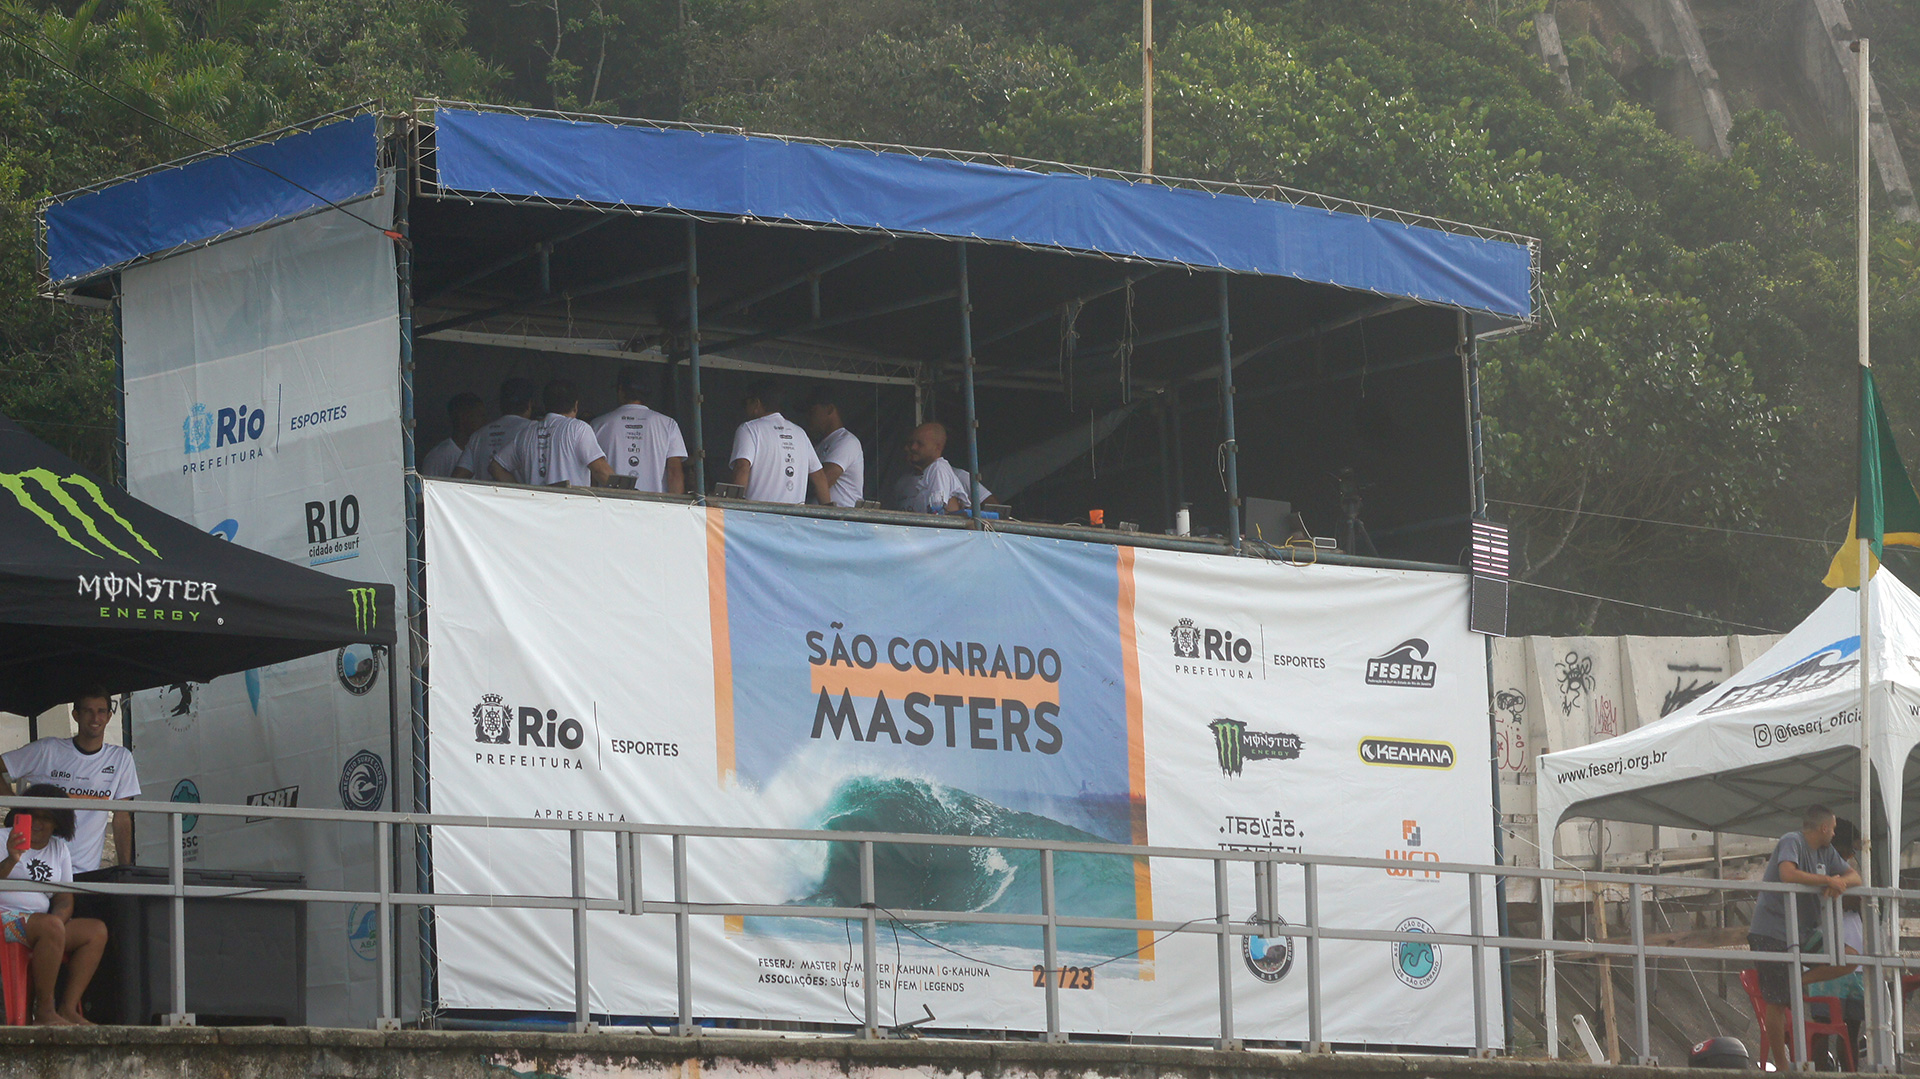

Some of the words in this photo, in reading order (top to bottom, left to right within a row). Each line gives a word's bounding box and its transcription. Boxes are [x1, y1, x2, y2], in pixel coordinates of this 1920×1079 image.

[216, 405, 265, 447] Rio
[290, 405, 347, 431] ESPORTES
[182, 448, 264, 476] PREFEITURA
[305, 494, 359, 544] RIO
[308, 544, 333, 557] cidade
[335, 542, 343, 552] do
[344, 537, 360, 551] surf
[100, 606, 201, 622] ENERGY
[805, 621, 878, 670] SÃO
[888, 637, 1062, 683] CONRADO
[1204, 628, 1252, 664] Rio
[1273, 654, 1326, 670] ESPORTES
[1175, 665, 1254, 680] PREFEITURA
[1369, 662, 1434, 681] FESERJ
[1712, 664, 1853, 708] FESERJ
[810, 685, 1063, 755] MASTERS
[518, 706, 584, 750] Rio
[611, 739, 679, 757] ESPORTES
[1243, 734, 1297, 749] MONSTER
[475, 753, 583, 770] PREFEITURA
[1376, 746, 1451, 764] KEAHANA
[1557, 750, 1667, 784] www.feserj.org.br
[69, 788, 111, 798] CONRADO
[534, 809, 627, 823] APRESENTA
[182, 836, 198, 848] SSC
[758, 958, 795, 969] FESERJ:
[800, 960, 836, 971] MASTER
[844, 963, 890, 973] G-MTER
[898, 964, 935, 975] KAHUNA
[942, 966, 990, 978] G-KAHUNA
[1033, 964, 1094, 990] 2/23
[758, 974, 828, 988] ASSOCIAÇÕES:
[830, 977, 860, 988] SUB-16
[898, 981, 918, 991] FEM
[924, 982, 965, 992] LEGENDS
